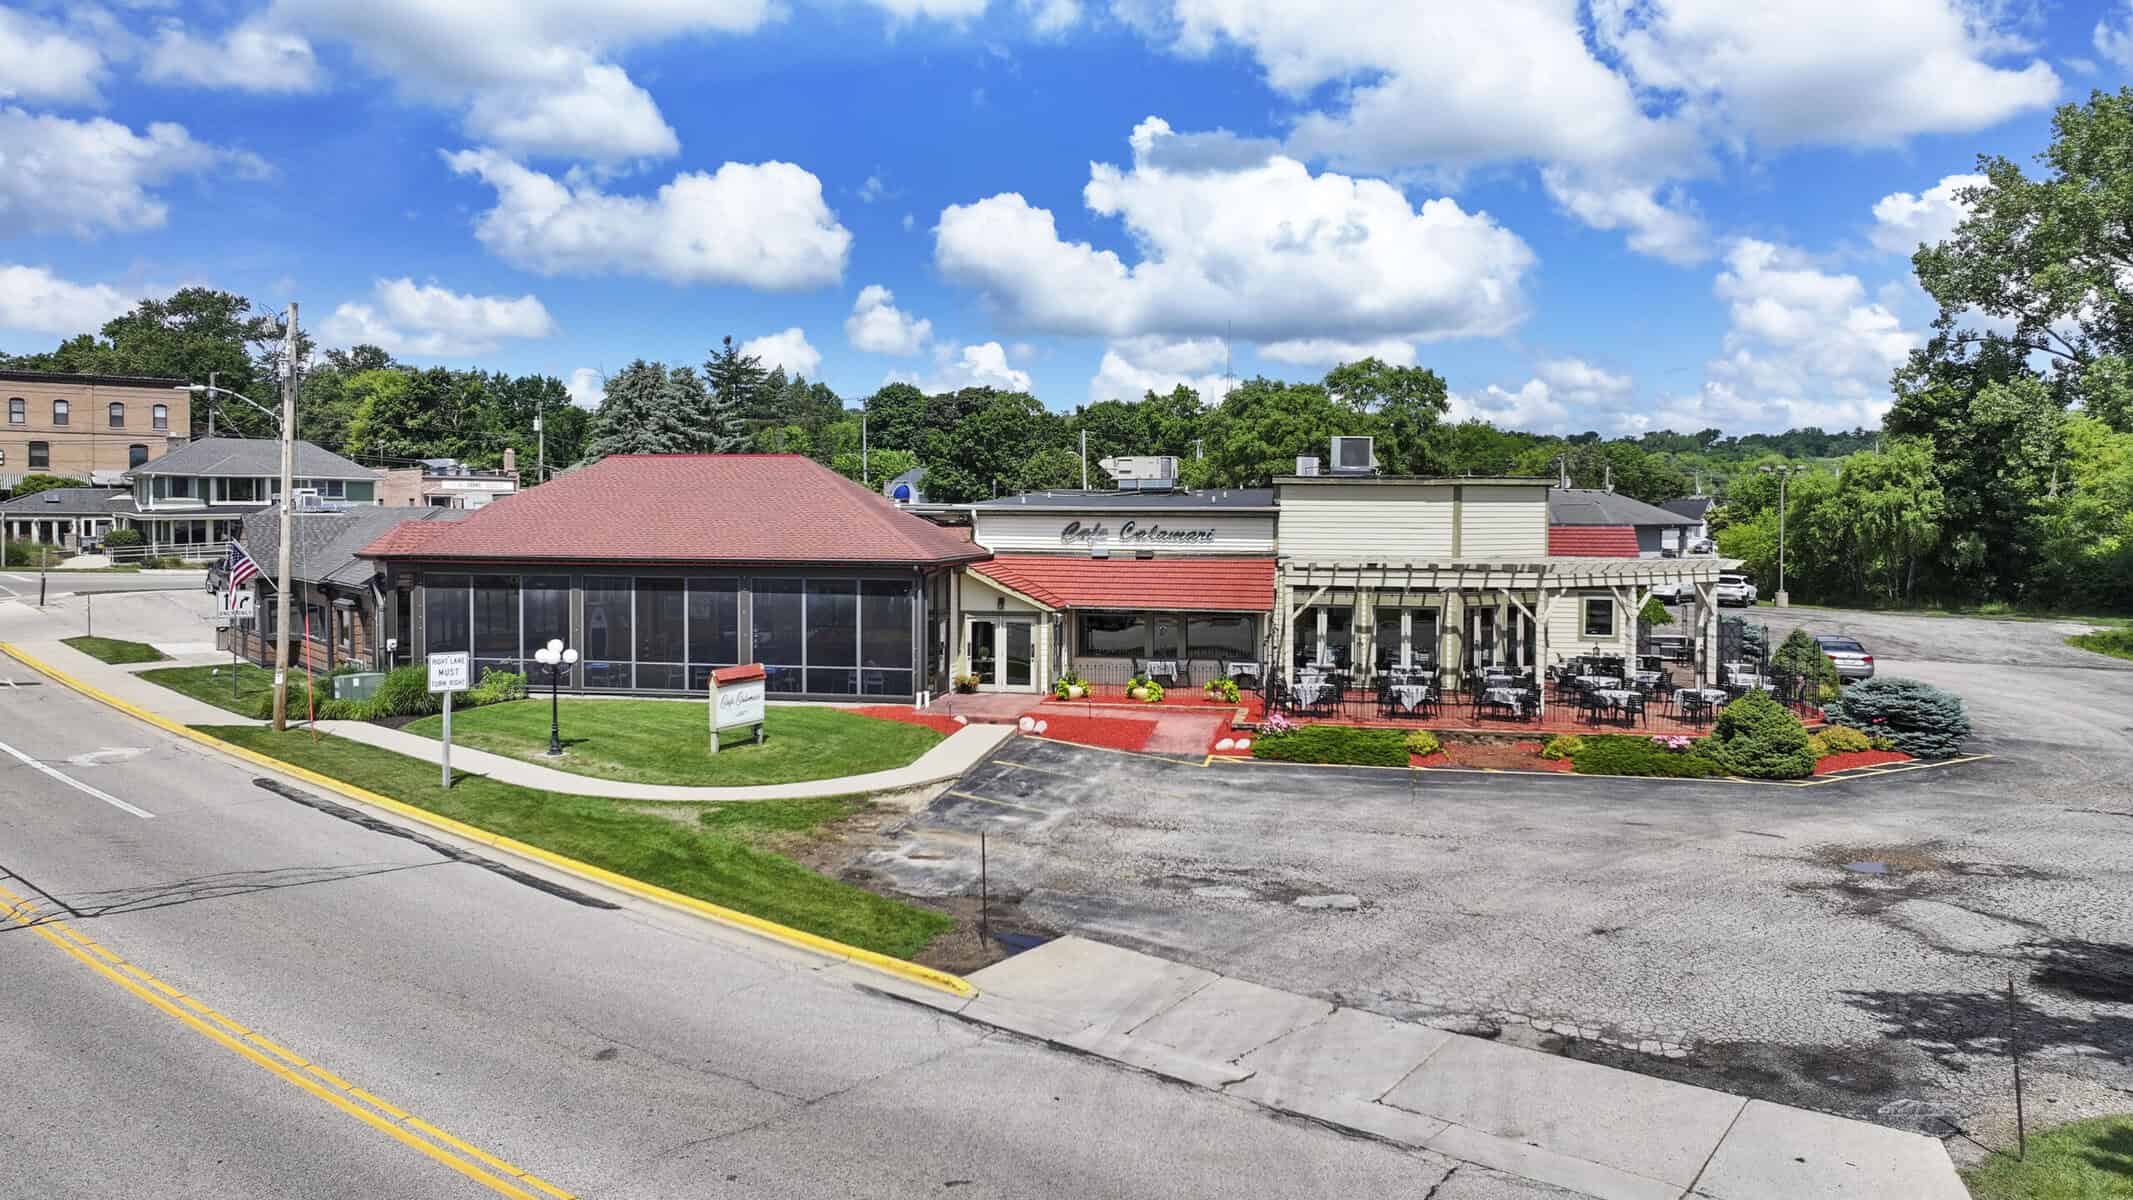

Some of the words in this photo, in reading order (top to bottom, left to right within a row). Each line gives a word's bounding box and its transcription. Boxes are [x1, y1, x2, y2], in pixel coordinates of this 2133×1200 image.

[1061, 520, 1109, 546] Cafe
[1119, 520, 1216, 543] Calamari
[438, 667, 459, 677] MUST
